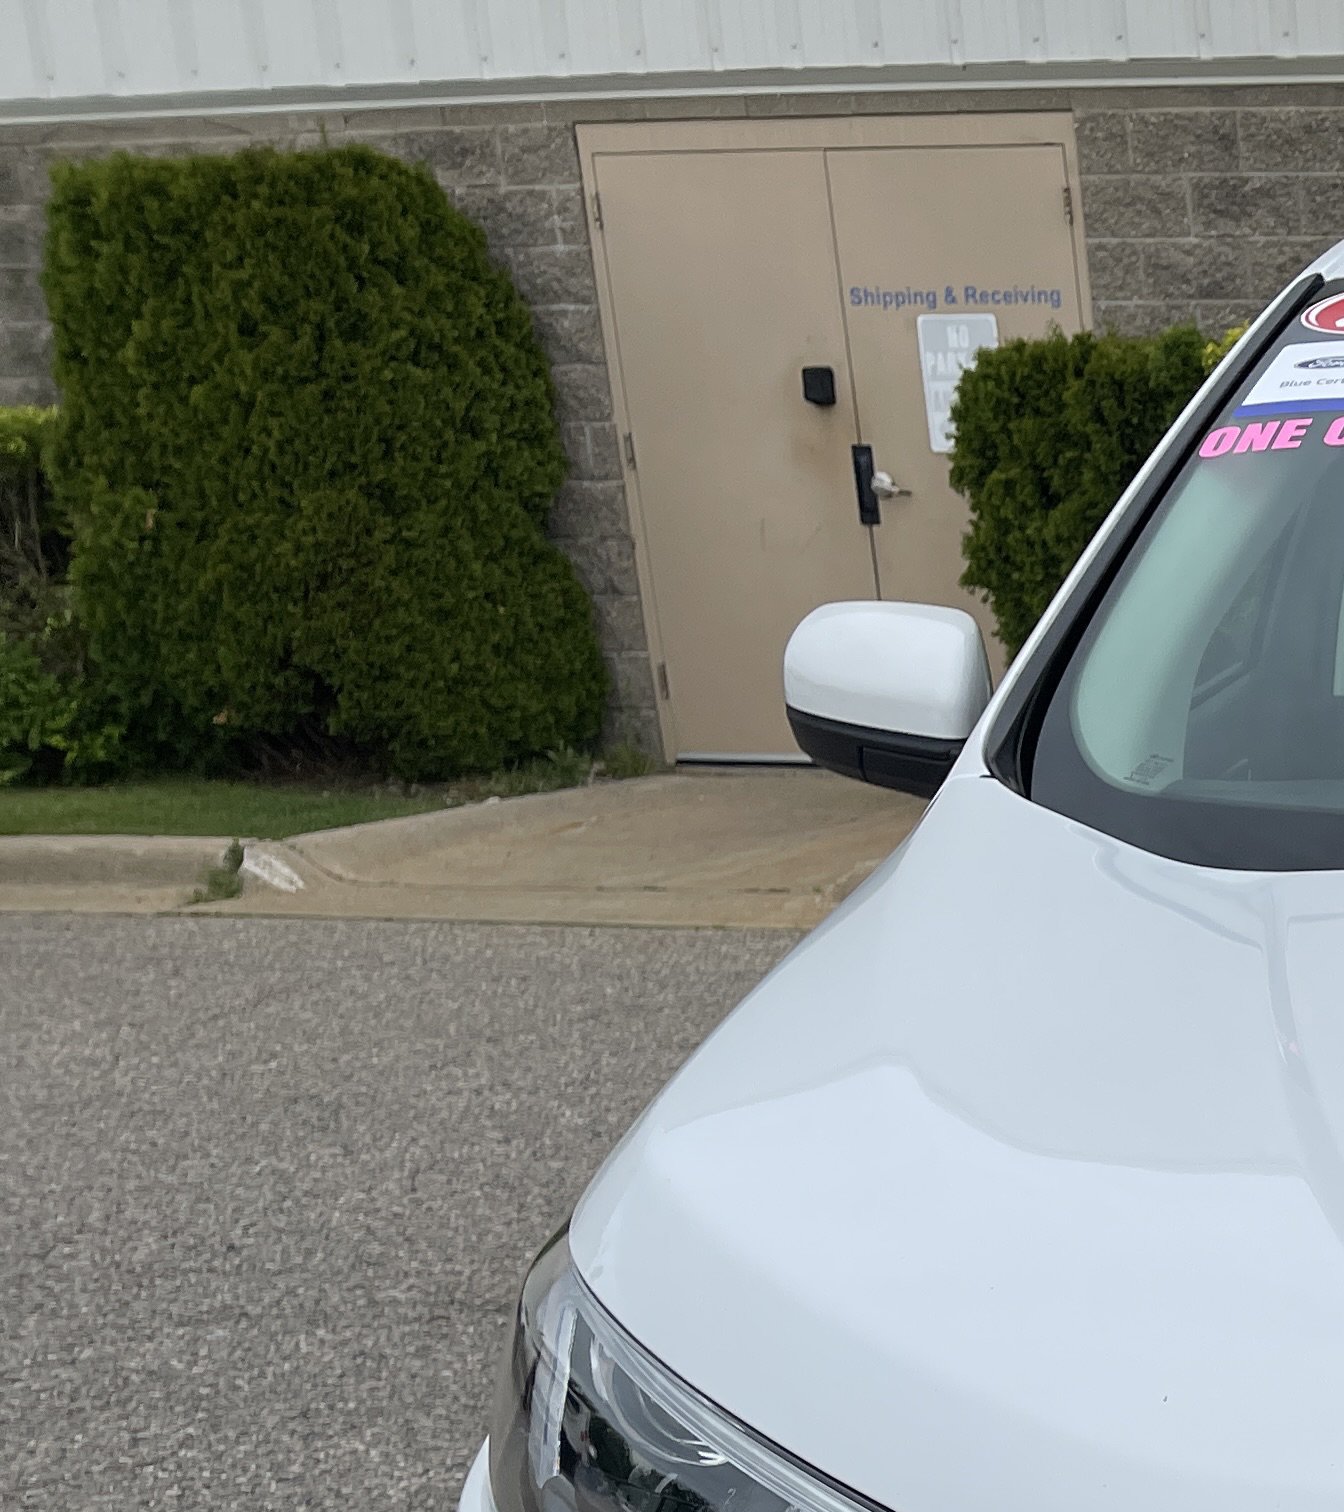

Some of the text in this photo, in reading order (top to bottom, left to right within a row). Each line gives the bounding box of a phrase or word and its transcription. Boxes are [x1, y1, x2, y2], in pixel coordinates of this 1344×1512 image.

[850, 285, 1062, 309] Shipping & Receiving
[946, 325, 970, 348] NO
[1279, 380, 1312, 389] Blue
[1199, 417, 1314, 458] ONE
